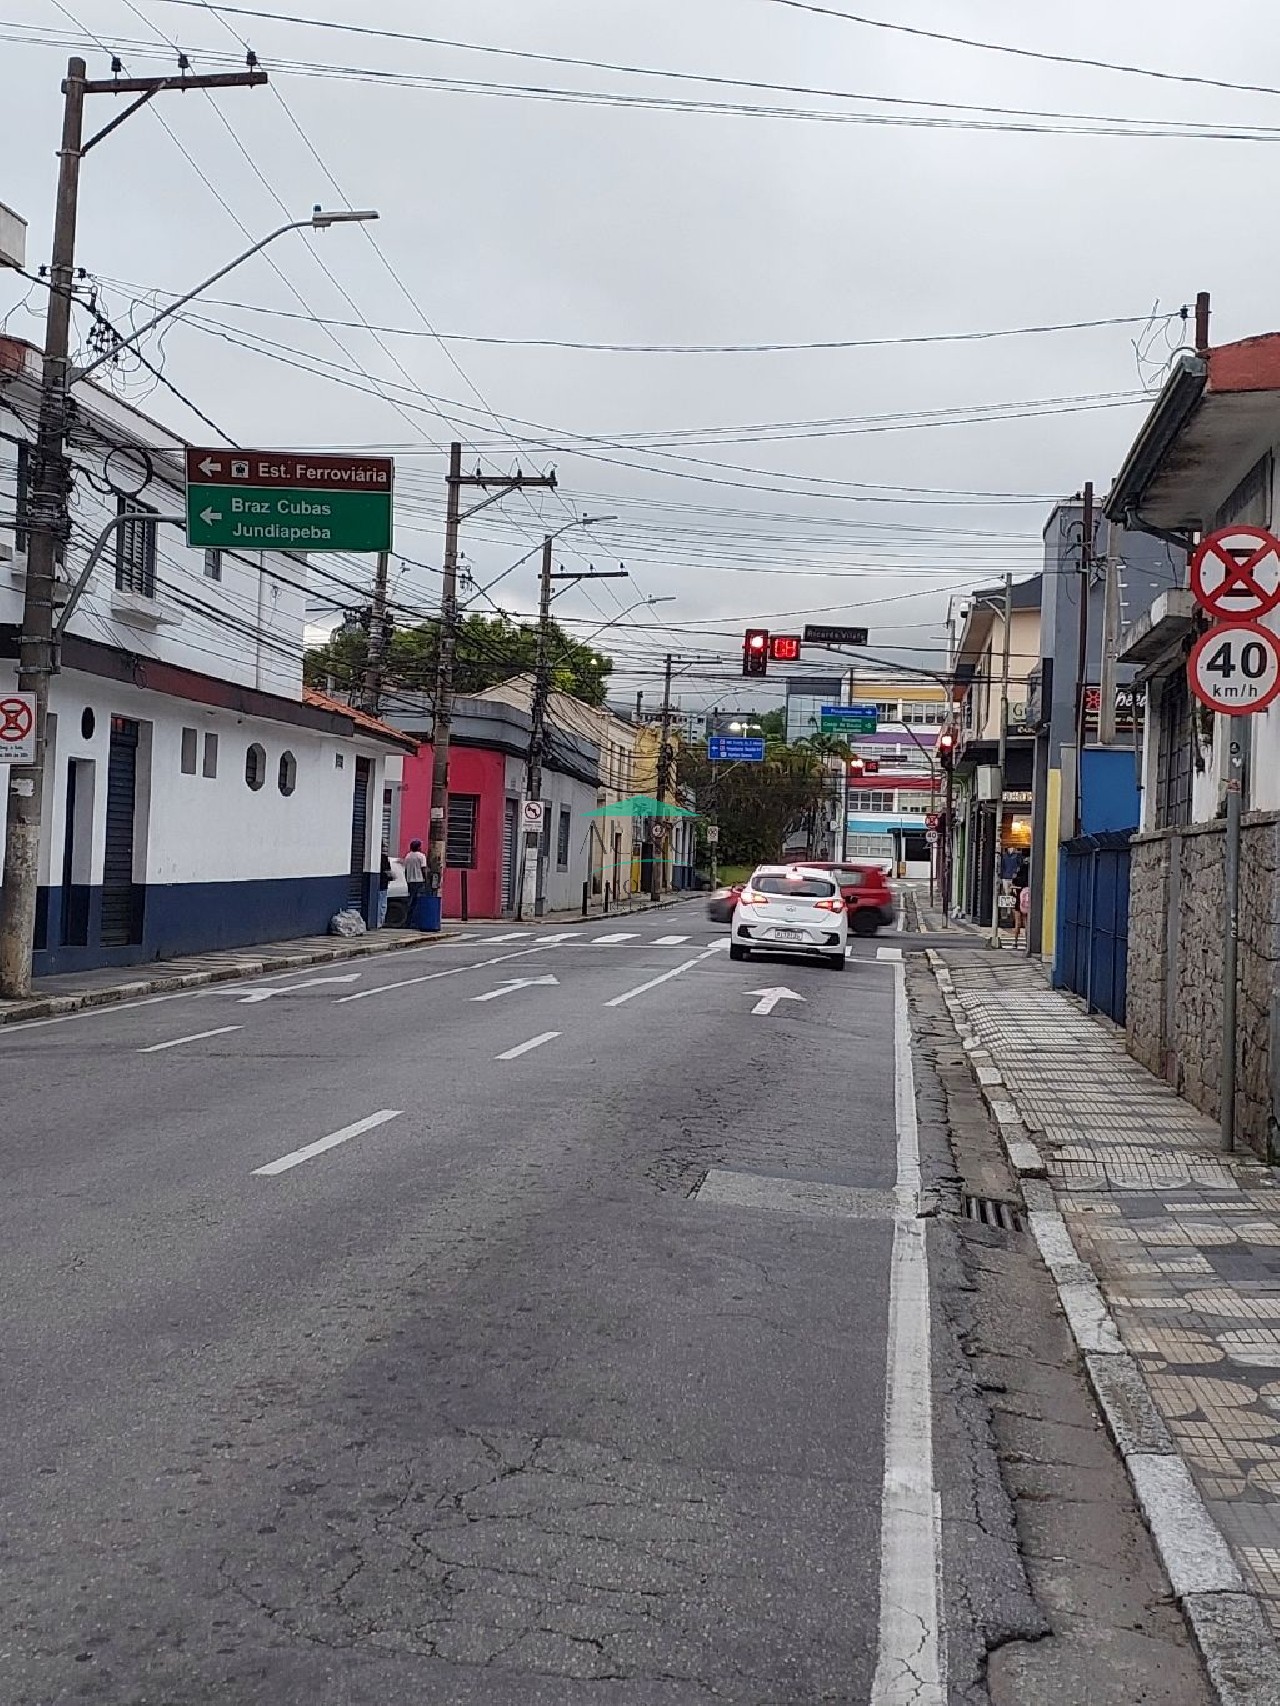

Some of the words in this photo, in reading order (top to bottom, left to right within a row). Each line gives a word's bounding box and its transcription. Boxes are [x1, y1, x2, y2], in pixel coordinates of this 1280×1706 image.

[258, 462, 290, 479] Est.
[296, 465, 387, 483] Ferroviária
[231, 498, 271, 513] Braz
[277, 500, 331, 515] Cubas
[232, 523, 331, 541] Jundiapeba
[1205, 641, 1268, 679] 40
[1212, 683, 1258, 697] km/h
